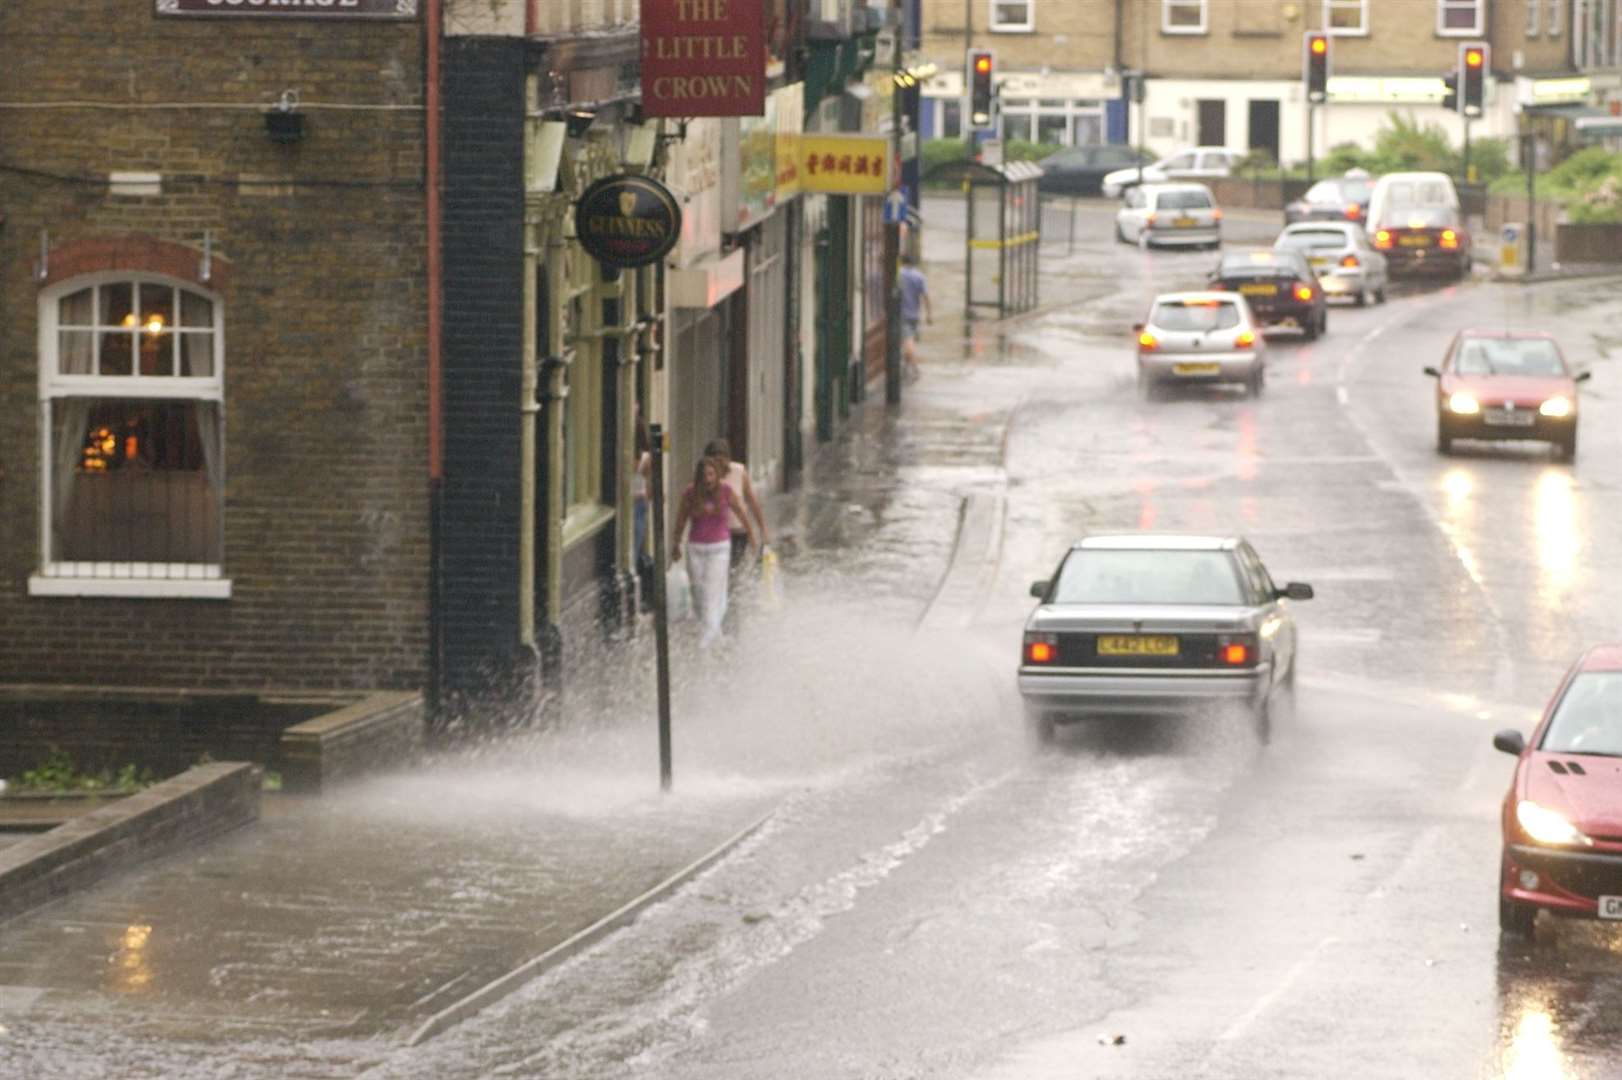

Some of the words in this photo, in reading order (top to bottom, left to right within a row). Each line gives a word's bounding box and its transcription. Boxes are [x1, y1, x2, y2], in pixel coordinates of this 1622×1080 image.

[676, 0, 728, 20] THE
[657, 35, 748, 59] LITTLE
[653, 75, 753, 100] CROWN
[588, 215, 666, 239] GUINNESS
